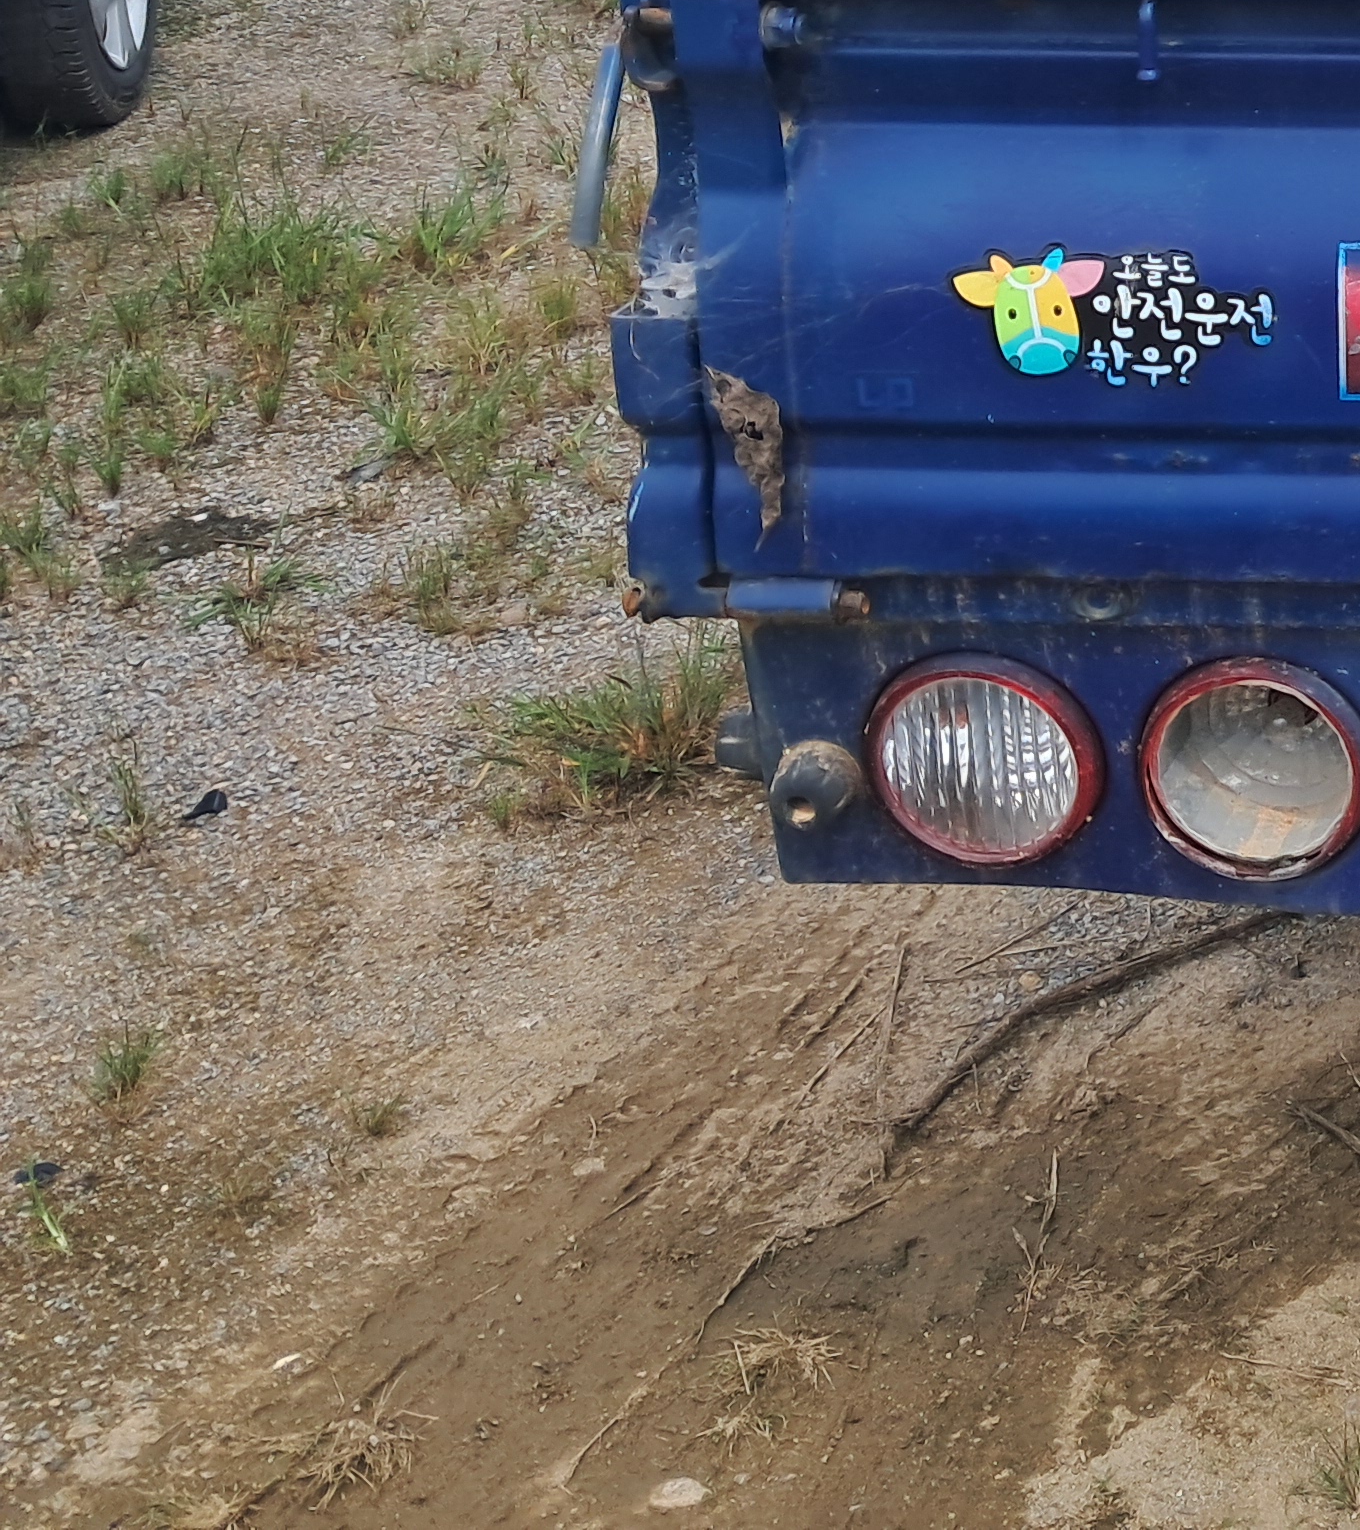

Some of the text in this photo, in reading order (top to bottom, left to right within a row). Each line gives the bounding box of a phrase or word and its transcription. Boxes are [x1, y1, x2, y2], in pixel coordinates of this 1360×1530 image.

[1112, 252, 1196, 288] 오늘도
[1092, 283, 1274, 347] 안전운전
[1087, 339, 1198, 388] 한우?
